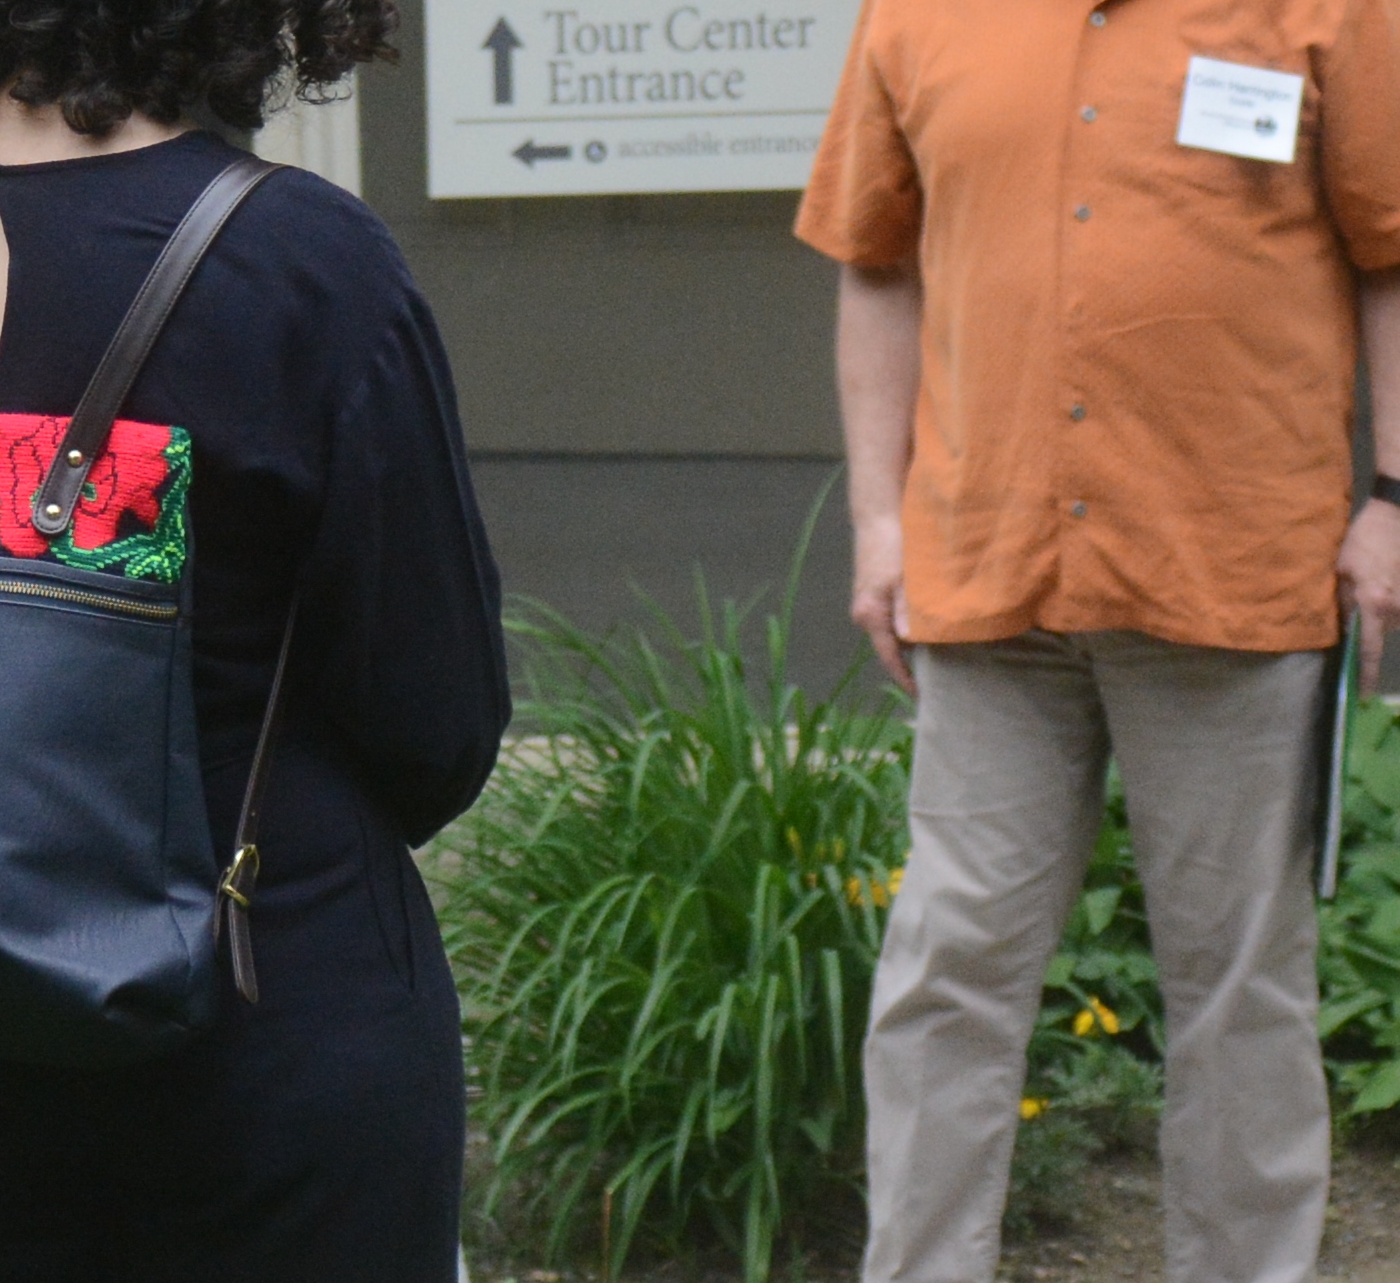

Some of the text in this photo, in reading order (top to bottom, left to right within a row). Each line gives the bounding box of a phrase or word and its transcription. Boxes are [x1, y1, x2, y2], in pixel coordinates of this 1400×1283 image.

[547, 8, 815, 55] Tour Center
[548, 61, 746, 105] Entrance
